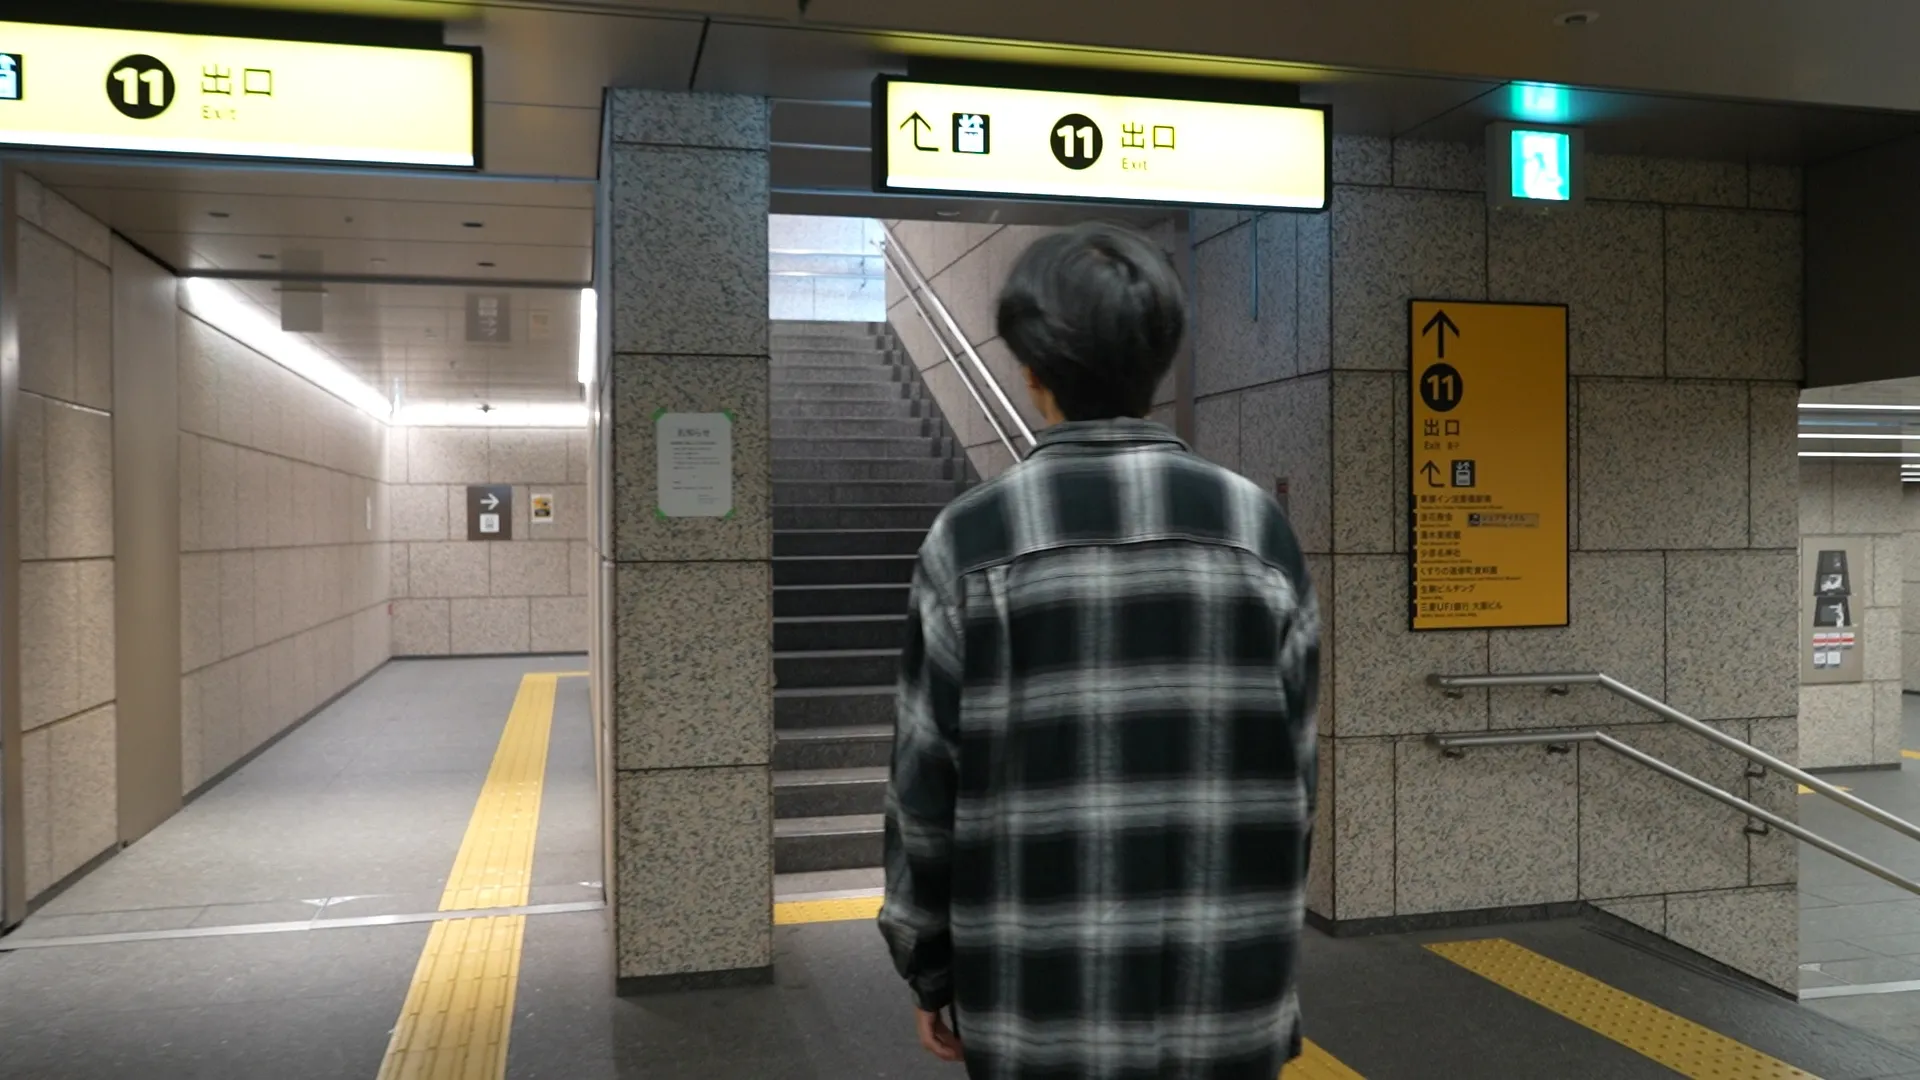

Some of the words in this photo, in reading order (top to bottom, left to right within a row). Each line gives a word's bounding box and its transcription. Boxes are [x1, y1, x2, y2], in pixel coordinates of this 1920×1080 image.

[113, 66, 165, 107] 11
[202, 63, 273, 96] 出口
[1056, 124, 1094, 160] 11
[1121, 121, 1175, 150] 出口
[1121, 157, 1148, 172] Exit
[1427, 374, 1454, 401] 11
[1423, 418, 1460, 436] 出口
[1472, 602, 1503, 611] 大ビル
